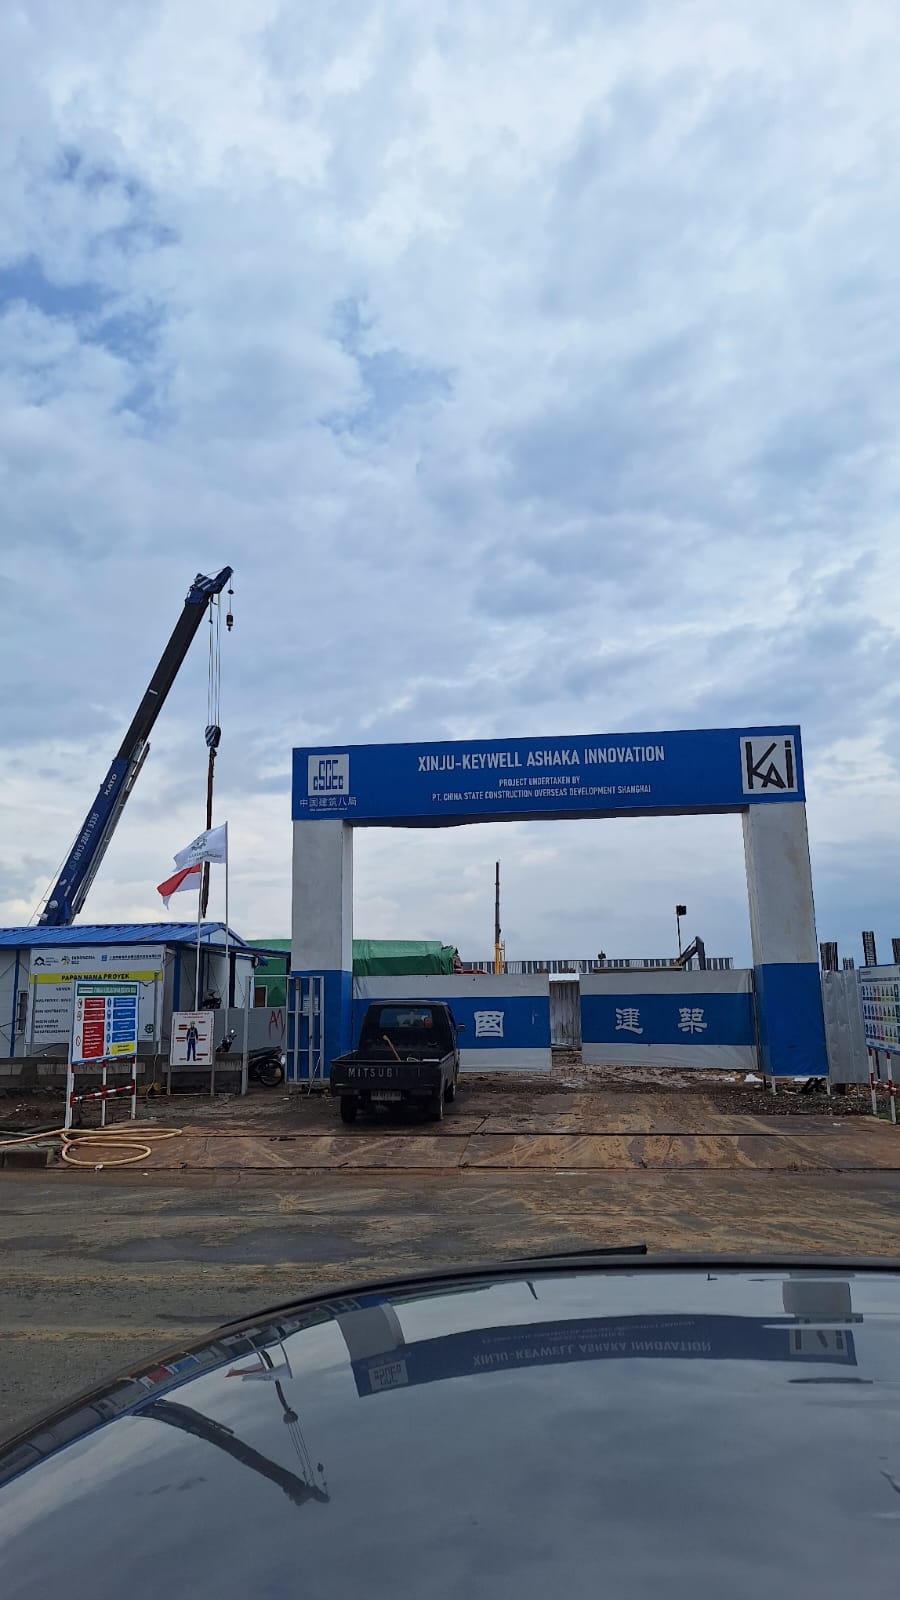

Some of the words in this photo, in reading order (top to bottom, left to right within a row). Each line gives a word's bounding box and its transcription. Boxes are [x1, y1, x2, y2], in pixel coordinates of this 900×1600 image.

[418, 752, 522, 772] XINJU-KEYWELL
[527, 750, 580, 767] ASHAKA
[584, 745, 664, 764] INNOVATION
[104, 773, 117, 796] KATO
[499, 778, 527, 787] PROJECT
[529, 776, 570, 786] UNDERTAKEN
[572, 776, 580, 784] BY
[443, 792, 462, 801] CHINA
[464, 791, 483, 800] STATE
[485, 789, 532, 799] CONSTRUCTION
[534, 787, 567, 797] OVERSEAS
[569, 785, 616, 796] DEVELOPMENT
[617, 784, 651, 794] SHANGHAI
